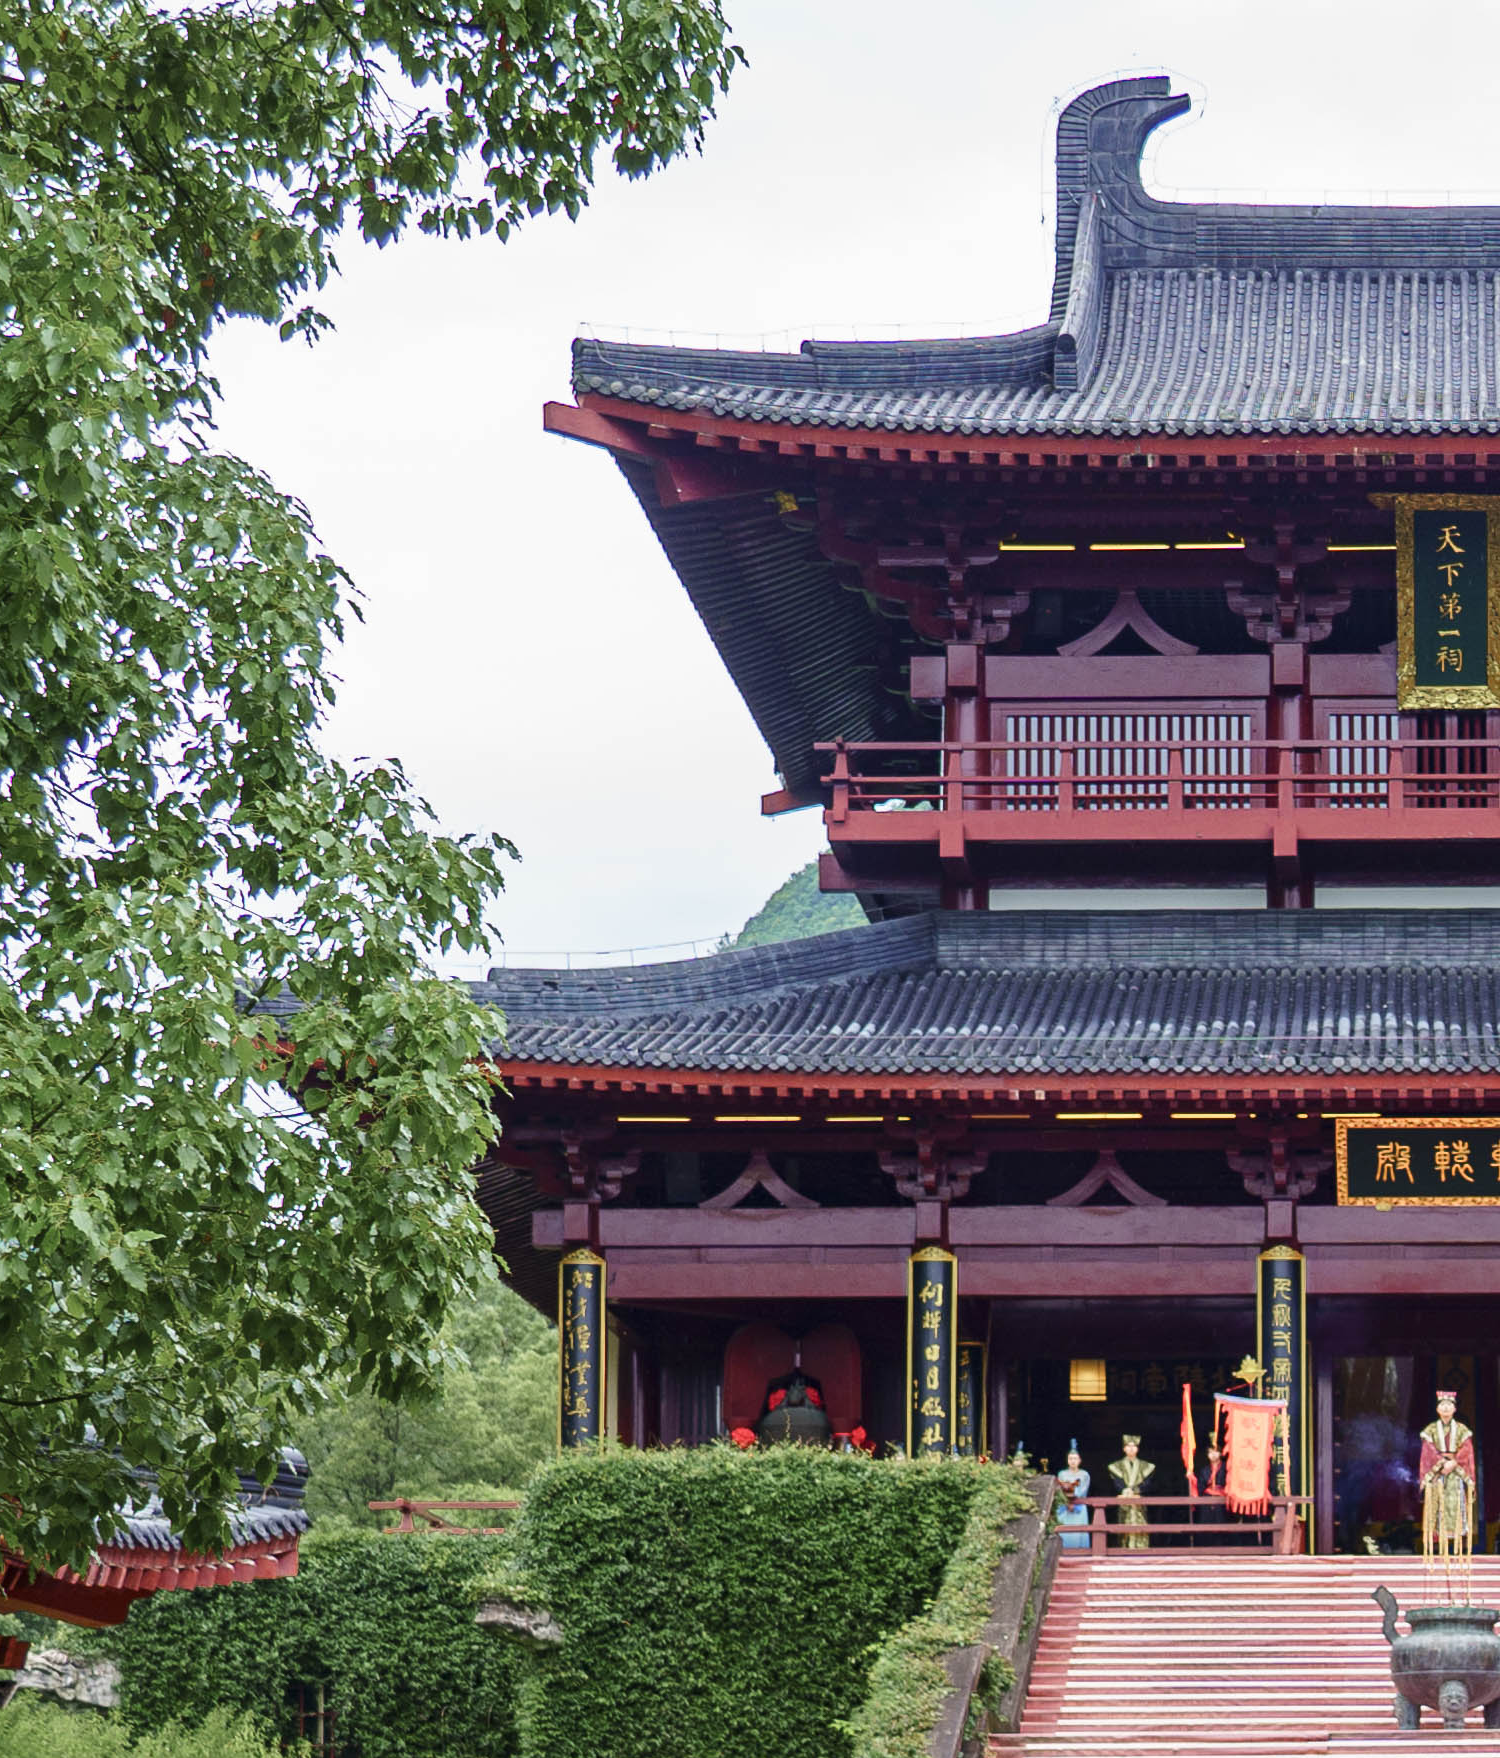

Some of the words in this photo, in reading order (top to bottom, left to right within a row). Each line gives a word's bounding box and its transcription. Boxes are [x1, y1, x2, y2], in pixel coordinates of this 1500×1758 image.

[1436, 525, 1466, 673] 天下第一祠
